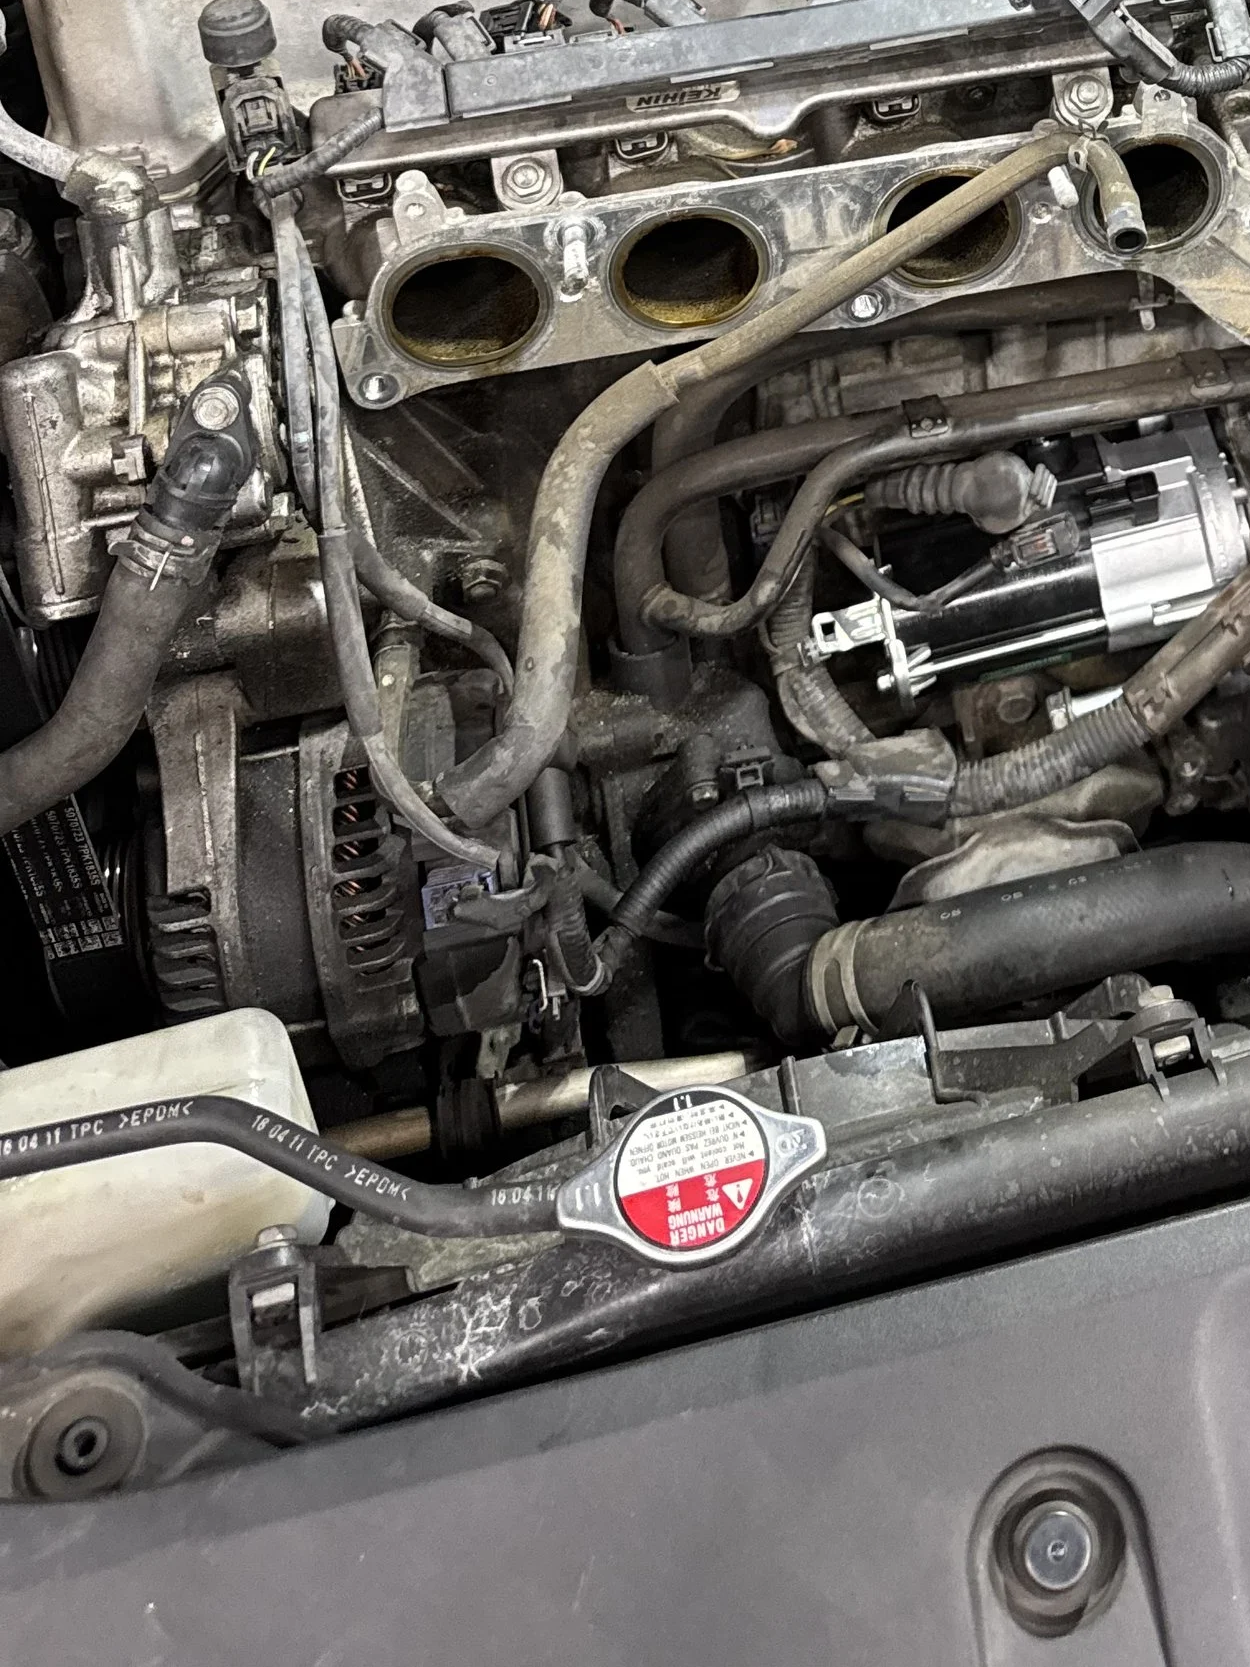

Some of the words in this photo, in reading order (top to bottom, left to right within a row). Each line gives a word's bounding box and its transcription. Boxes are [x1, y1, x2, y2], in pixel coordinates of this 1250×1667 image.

[636, 86, 721, 106] KEIHIN
[673, 1094, 693, 1112] 1.1
[18, 1134, 38, 1152] 04
[70, 1119, 104, 1139] TPC
[268, 1124, 290, 1143] 04
[306, 1144, 338, 1171] TPC
[685, 1142, 699, 1153] PAS
[700, 1158, 719, 1171] OPEN
[724, 1152, 746, 1165] NEVER
[674, 1165, 695, 1178] WHEN
[511, 1185, 533, 1204] 04
[575, 1182, 601, 1211] 1.1
[667, 1202, 724, 1230] WARNUNG
[669, 1217, 726, 1246] DANGER
